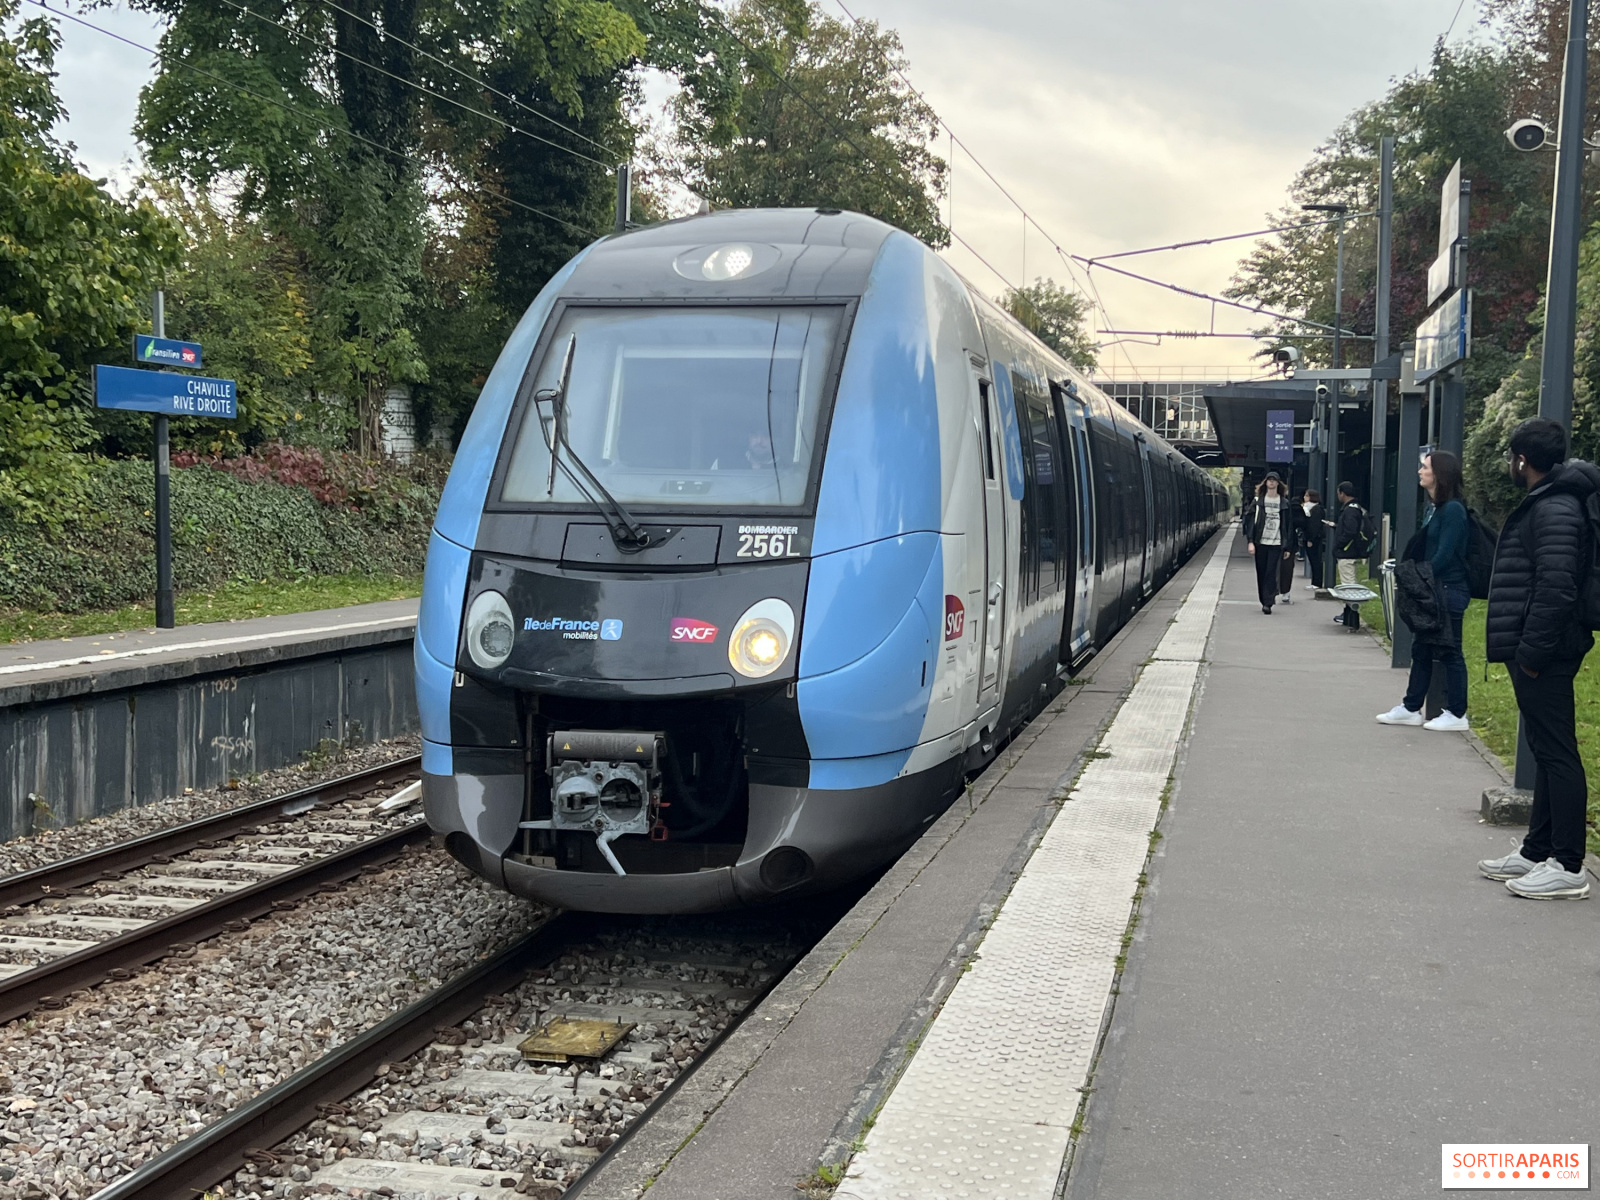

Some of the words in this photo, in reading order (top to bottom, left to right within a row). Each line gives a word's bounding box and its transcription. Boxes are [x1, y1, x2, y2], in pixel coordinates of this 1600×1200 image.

[187, 380, 231, 398] CHAVILLE
[173, 395, 195, 411] RIVE
[197, 397, 231, 414] DROITE
[738, 525, 798, 535] BOMBARDIER
[736, 534, 800, 558] 256L
[946, 610, 964, 636] SNCF
[562, 631, 598, 640] mobilités
[671, 626, 716, 640] SNCF
